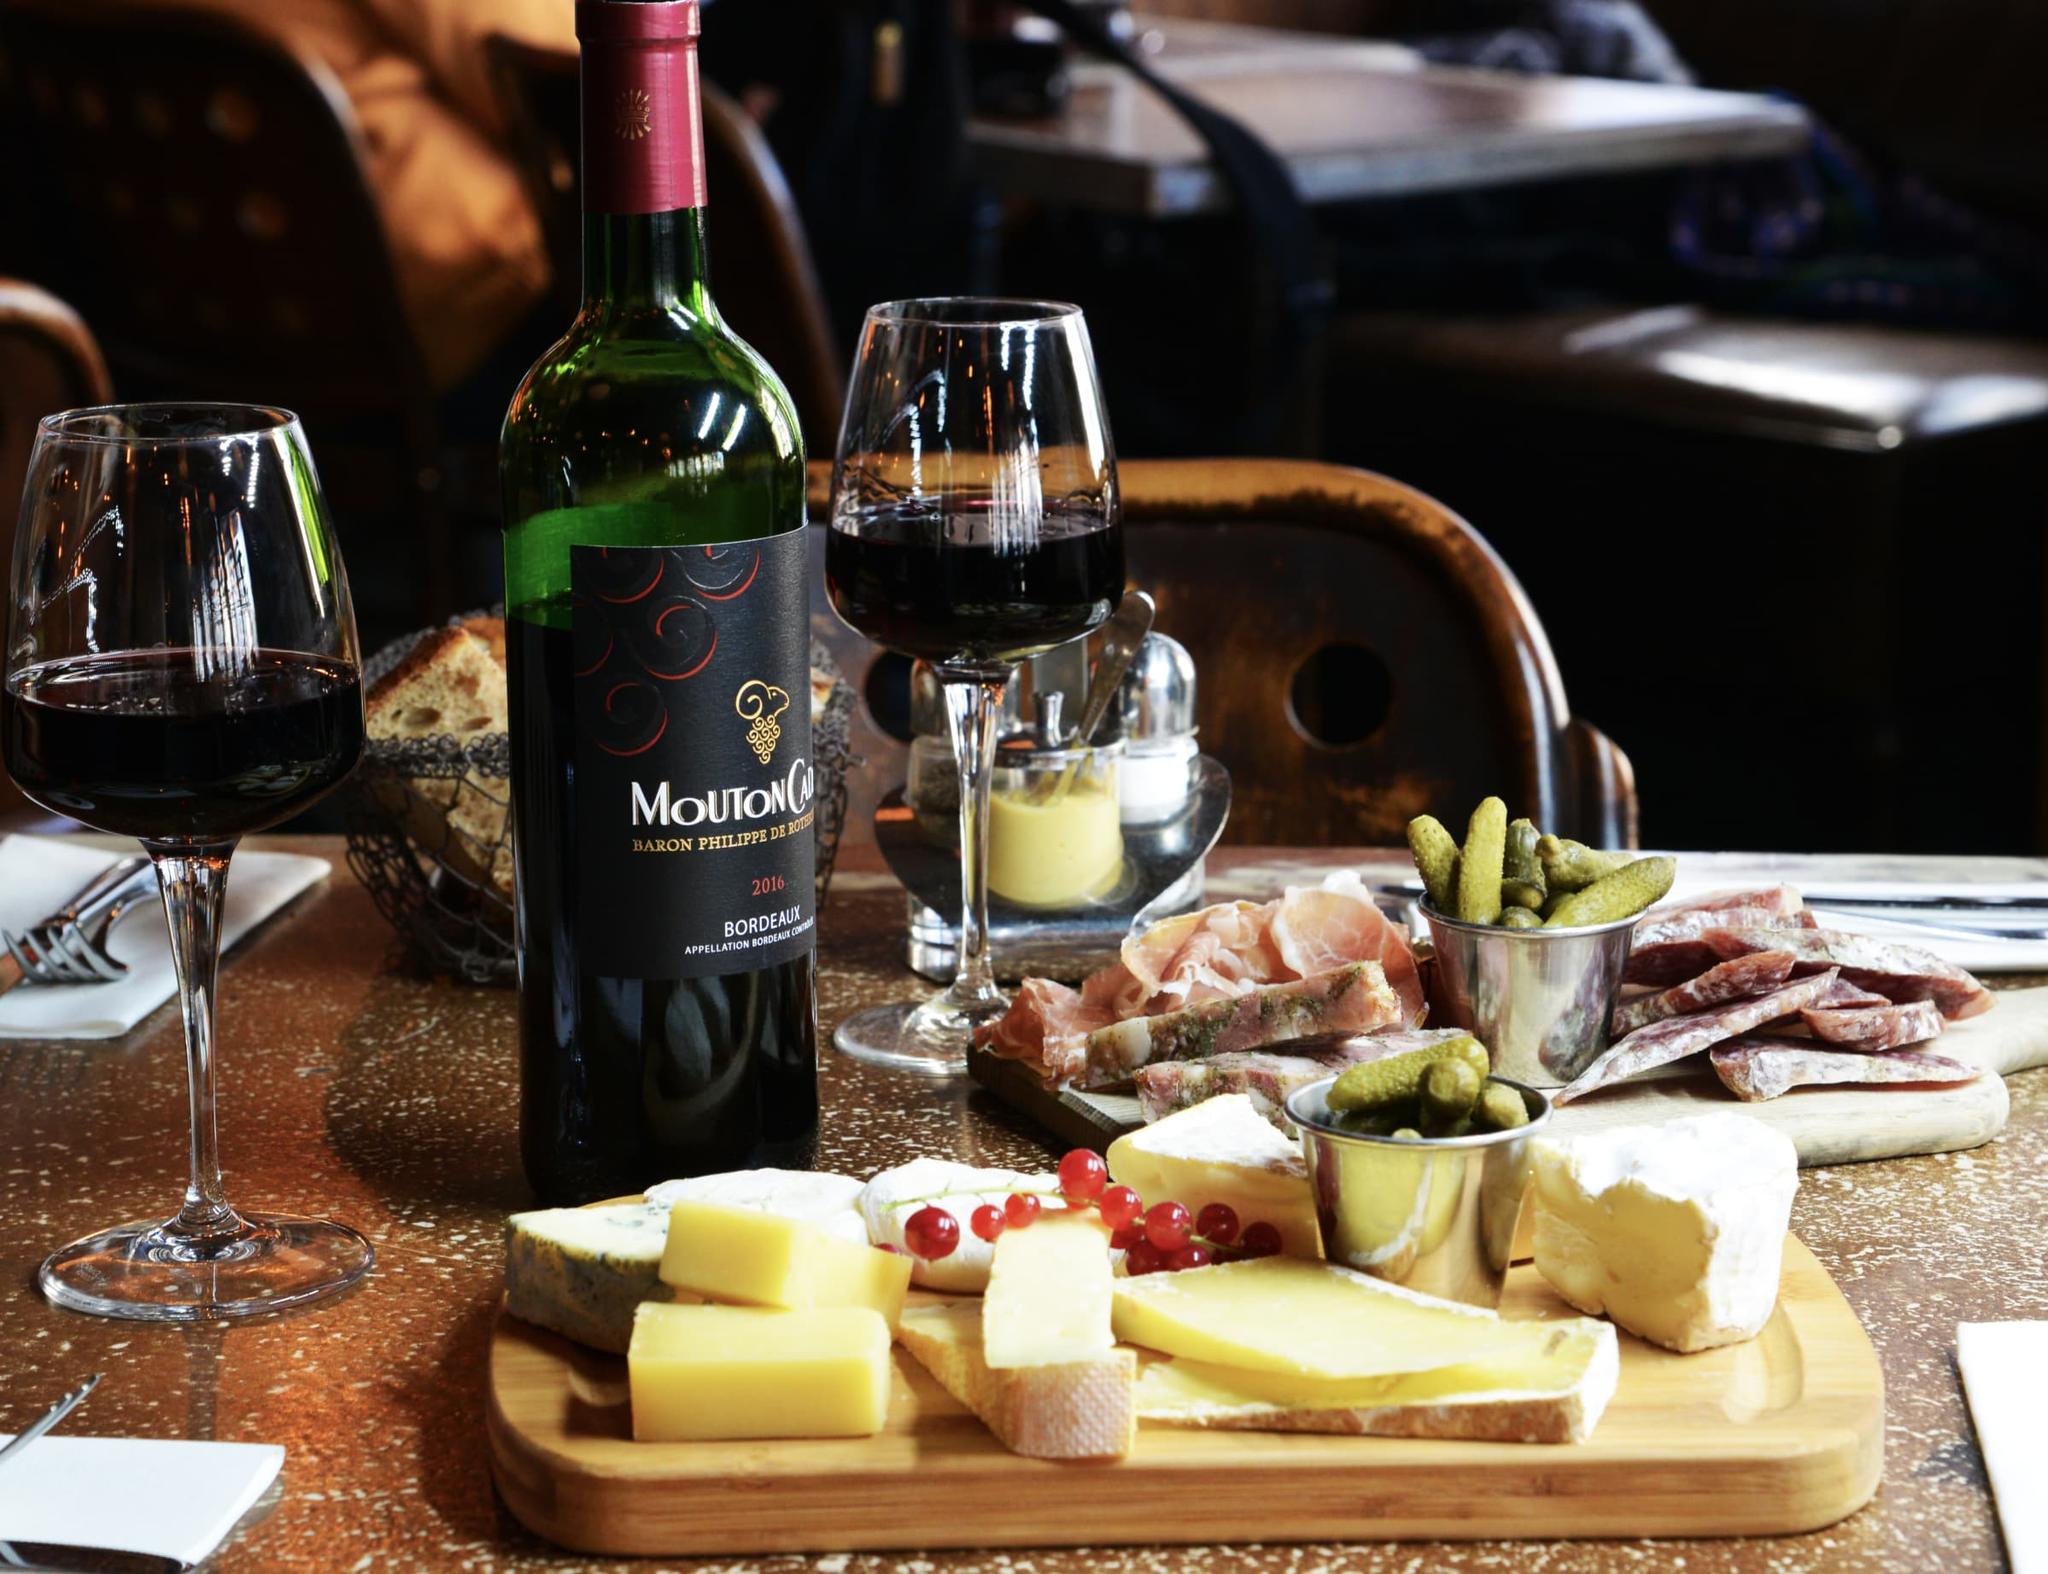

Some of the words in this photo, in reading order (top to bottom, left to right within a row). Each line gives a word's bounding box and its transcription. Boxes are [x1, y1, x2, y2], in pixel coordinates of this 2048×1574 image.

[631, 778, 786, 826] MOUTON
[632, 838, 693, 852] BARON
[698, 829, 767, 850] PHILIPPE
[770, 824, 786, 840] DE
[752, 874, 785, 896] 2016
[724, 904, 800, 937] BORDEAUX
[684, 940, 750, 955] APPELLATION
[752, 930, 790, 948] BORDEAUX
